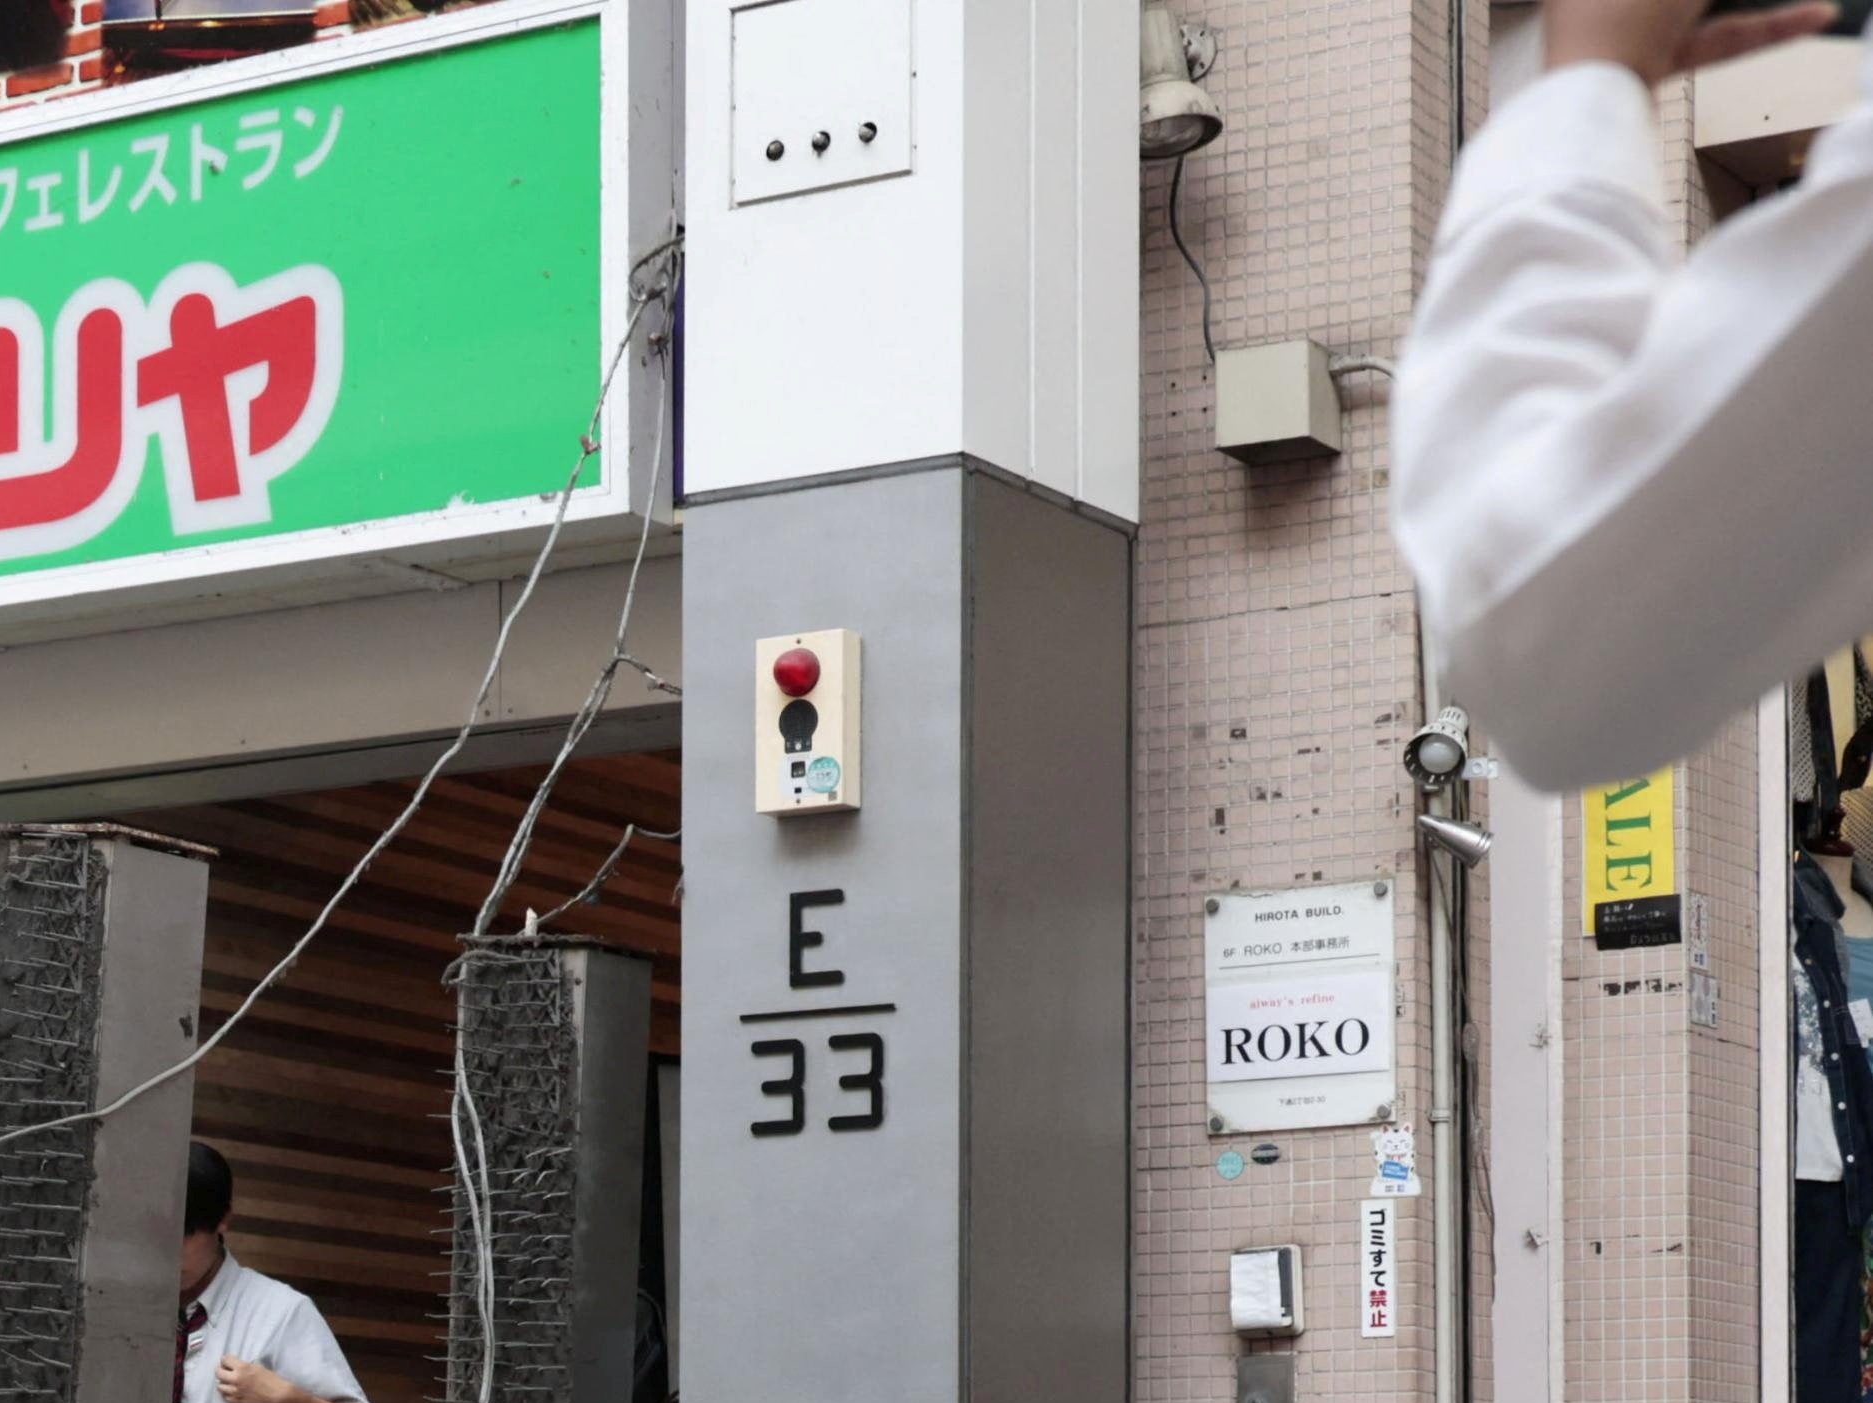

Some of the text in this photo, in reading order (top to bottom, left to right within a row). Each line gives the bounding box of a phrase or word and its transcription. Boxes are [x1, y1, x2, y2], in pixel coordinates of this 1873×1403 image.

[788, 888, 845, 989] E
[1254, 907, 1299, 923] HIROTA
[1222, 936, 1351, 959] 6F ROKO 本部事務所
[1300, 993, 1336, 1006] refine
[1220, 1017, 1371, 1067] ROKO
[750, 1031, 885, 1137] 33
[1368, 1207, 1388, 1328] ゴミすて禁止
